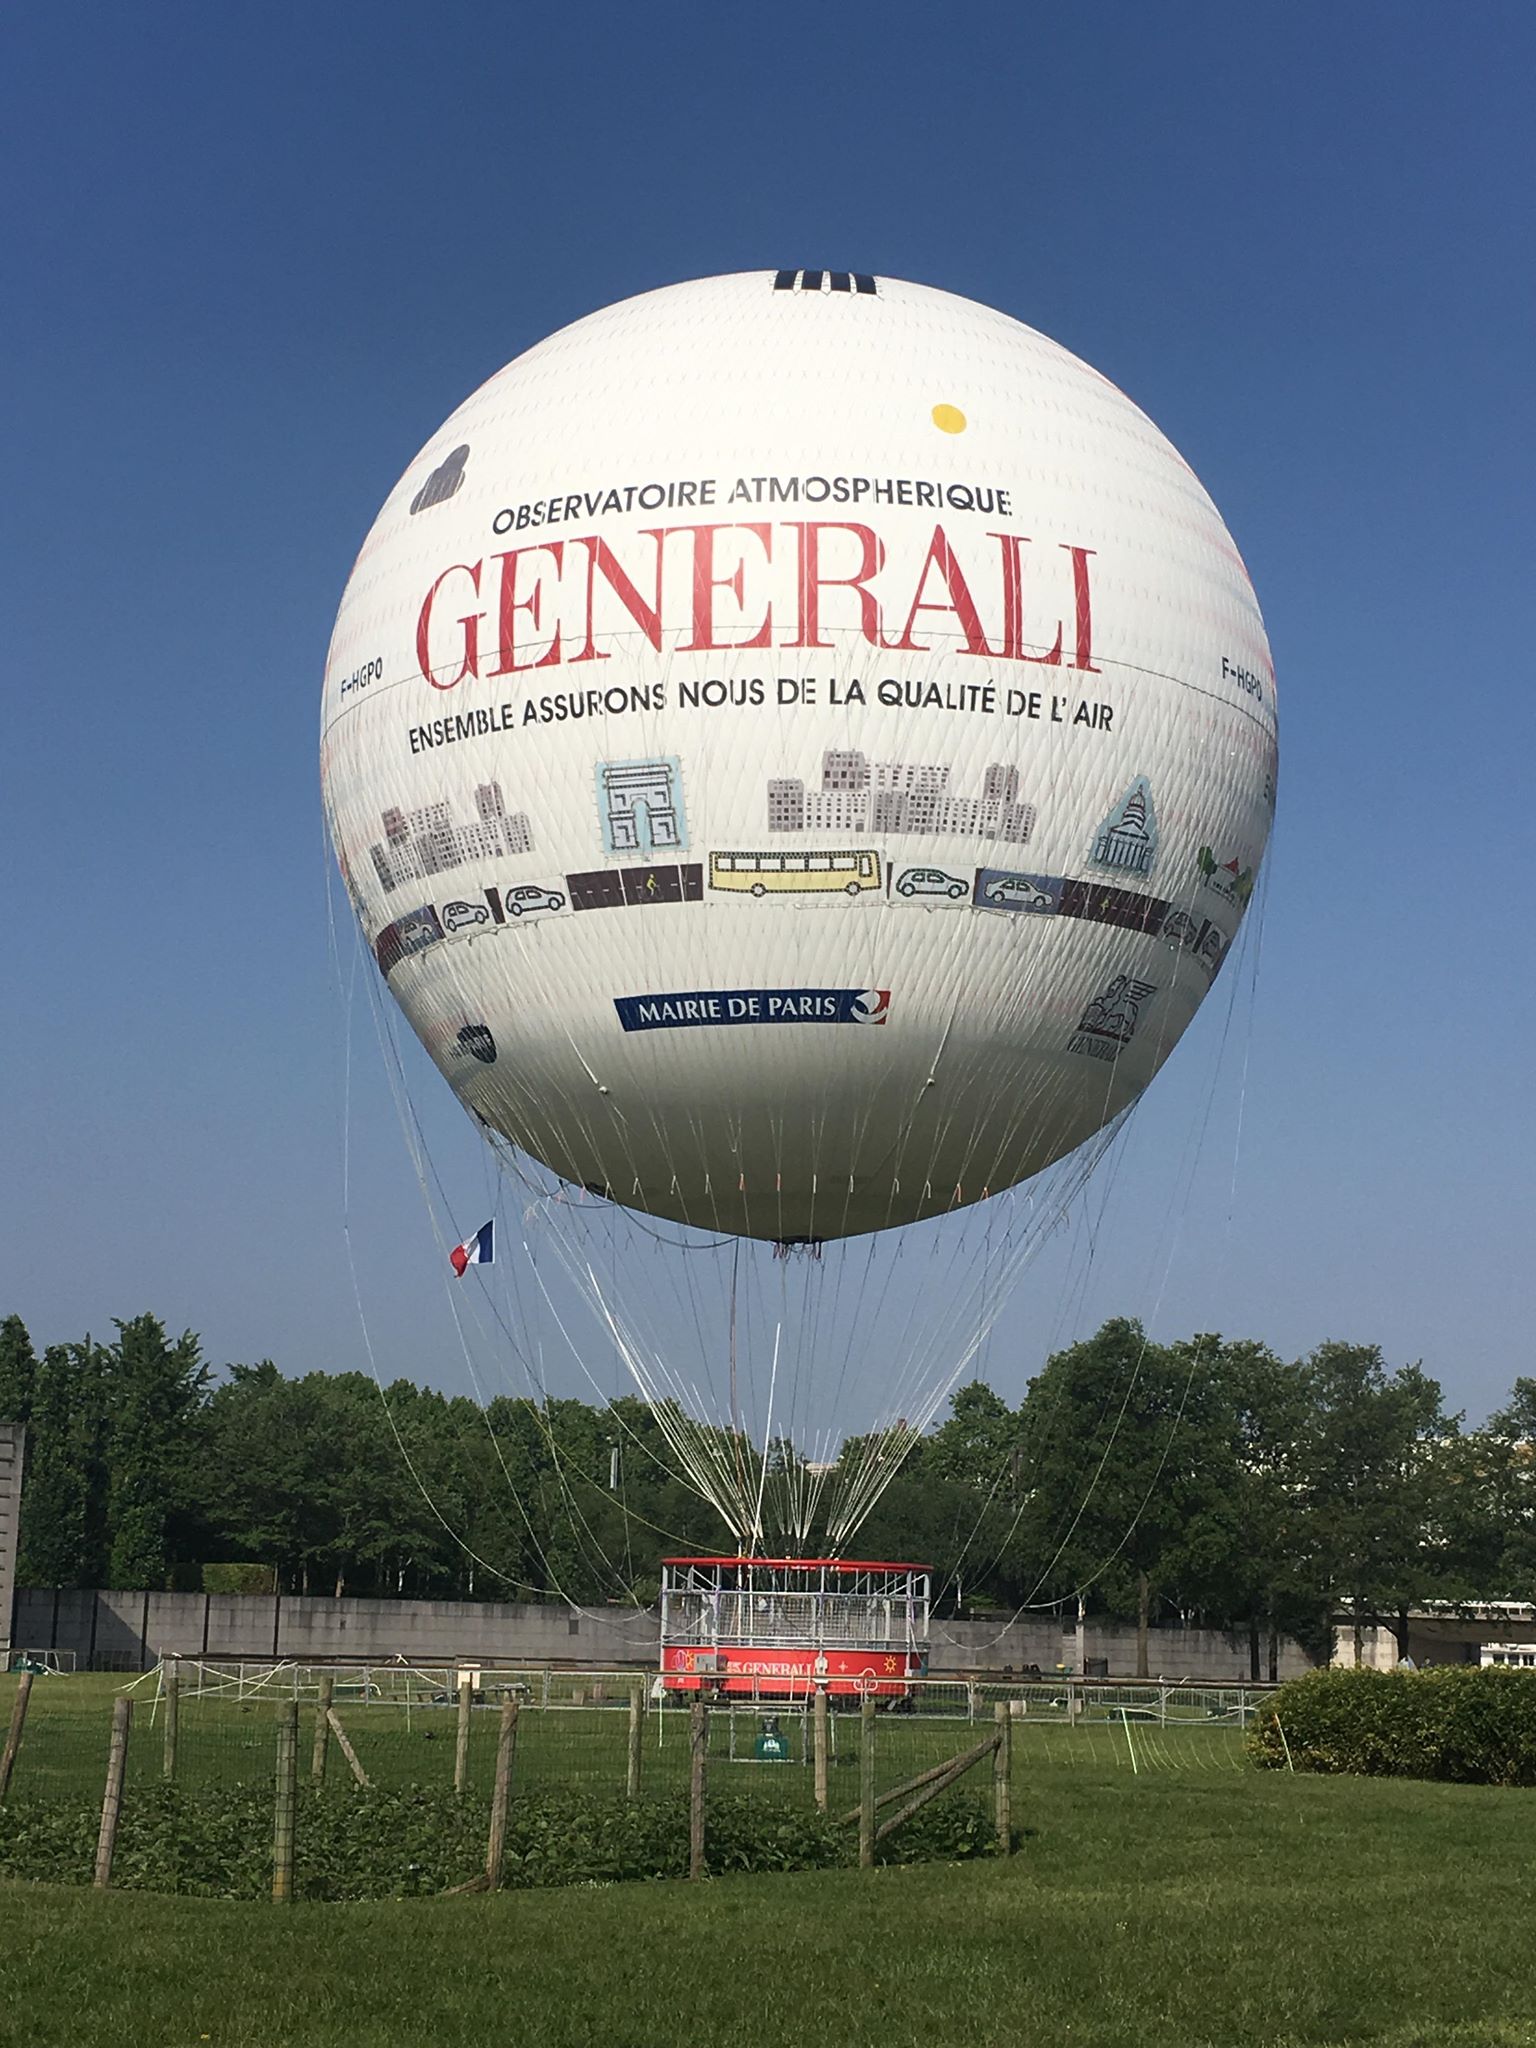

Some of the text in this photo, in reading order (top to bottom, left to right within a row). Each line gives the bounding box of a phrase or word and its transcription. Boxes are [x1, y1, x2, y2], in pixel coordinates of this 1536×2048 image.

[492, 476, 1013, 535] OBSERVATOIRE ATMOSPHERIQUE
[416, 521, 1102, 690] GENERALI
[408, 703, 515, 755] ENSEMBLE
[522, 682, 666, 727] ASSURONS
[679, 678, 764, 709] NOUS
[777, 677, 816, 707] DE
[829, 678, 867, 707] LA
[877, 678, 996, 715] QUALITÉ
[1005, 689, 1042, 721] DE
[1072, 701, 1114, 732] AIR
[638, 996, 837, 1023] MAIRIE DE PARIS
